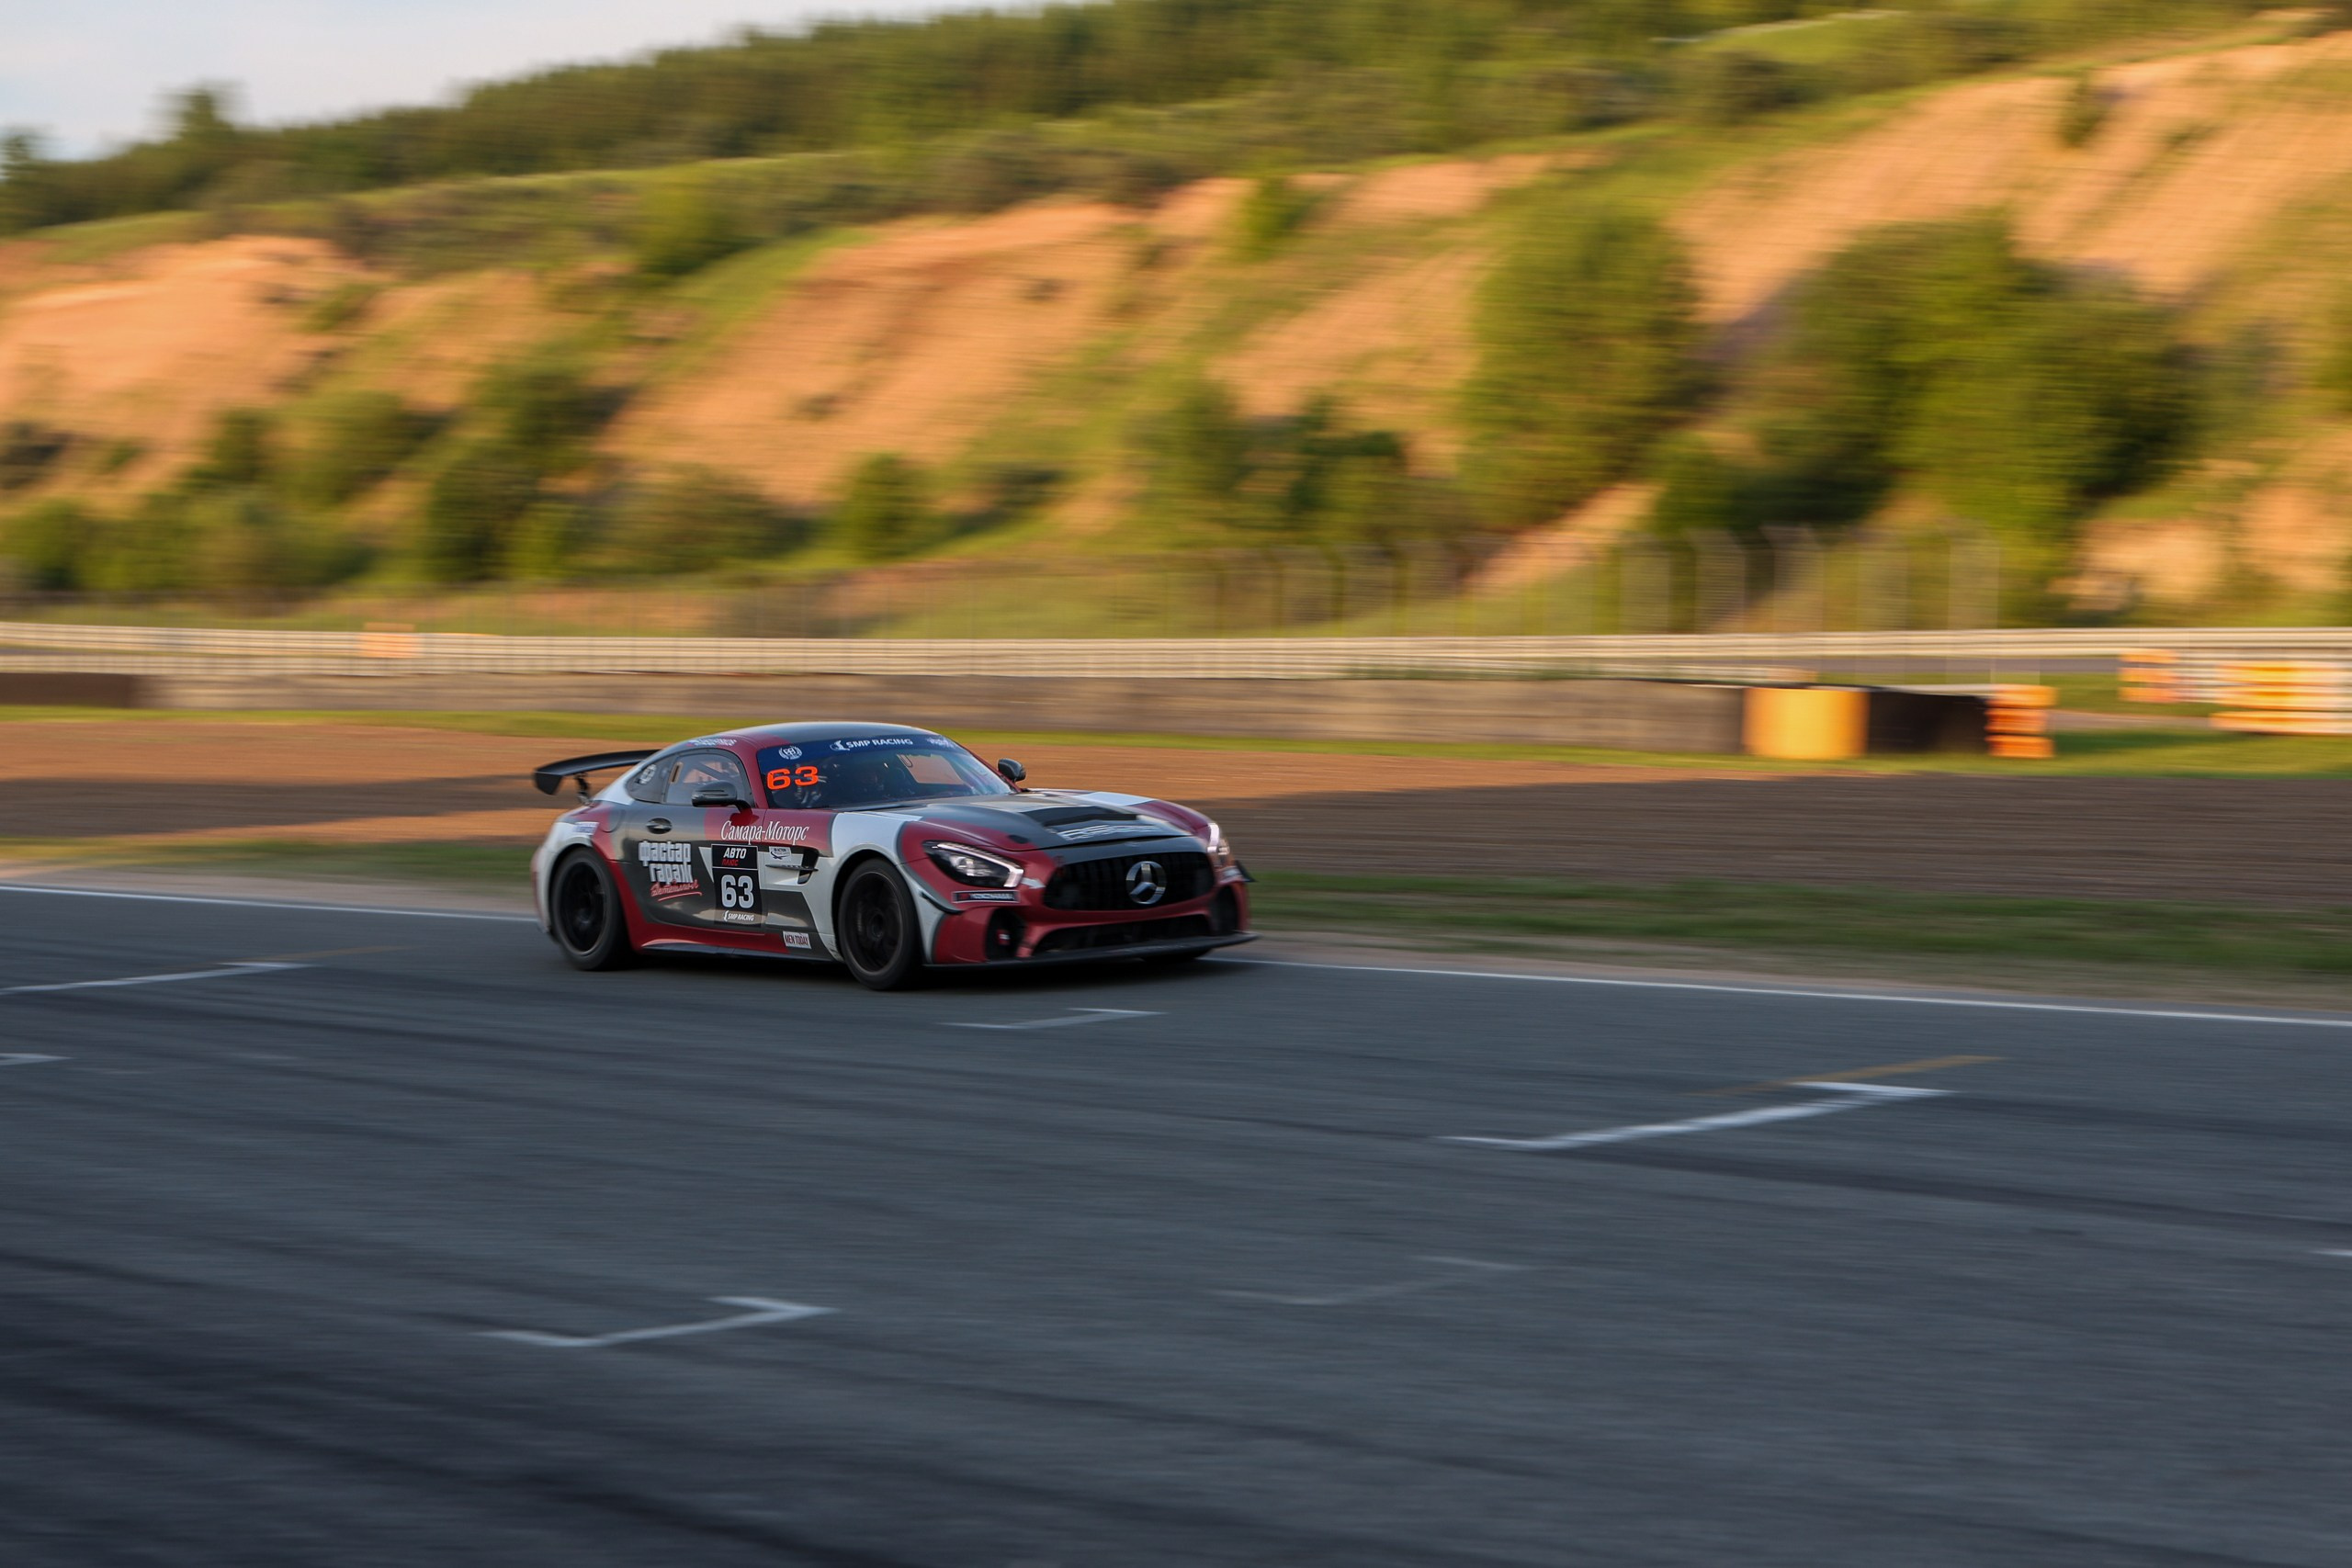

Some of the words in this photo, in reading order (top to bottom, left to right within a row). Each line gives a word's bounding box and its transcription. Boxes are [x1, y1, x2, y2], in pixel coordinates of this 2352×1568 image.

[846, 739, 871, 749] SMP
[872, 738, 913, 746] RACING
[766, 765, 819, 791] 63
[720, 820, 810, 846] Самара-Моторс
[723, 847, 747, 860] АВТО
[720, 874, 755, 909] 63
[738, 913, 754, 921] RACING
[785, 934, 796, 944] MEN
[795, 935, 808, 946] TODAY
